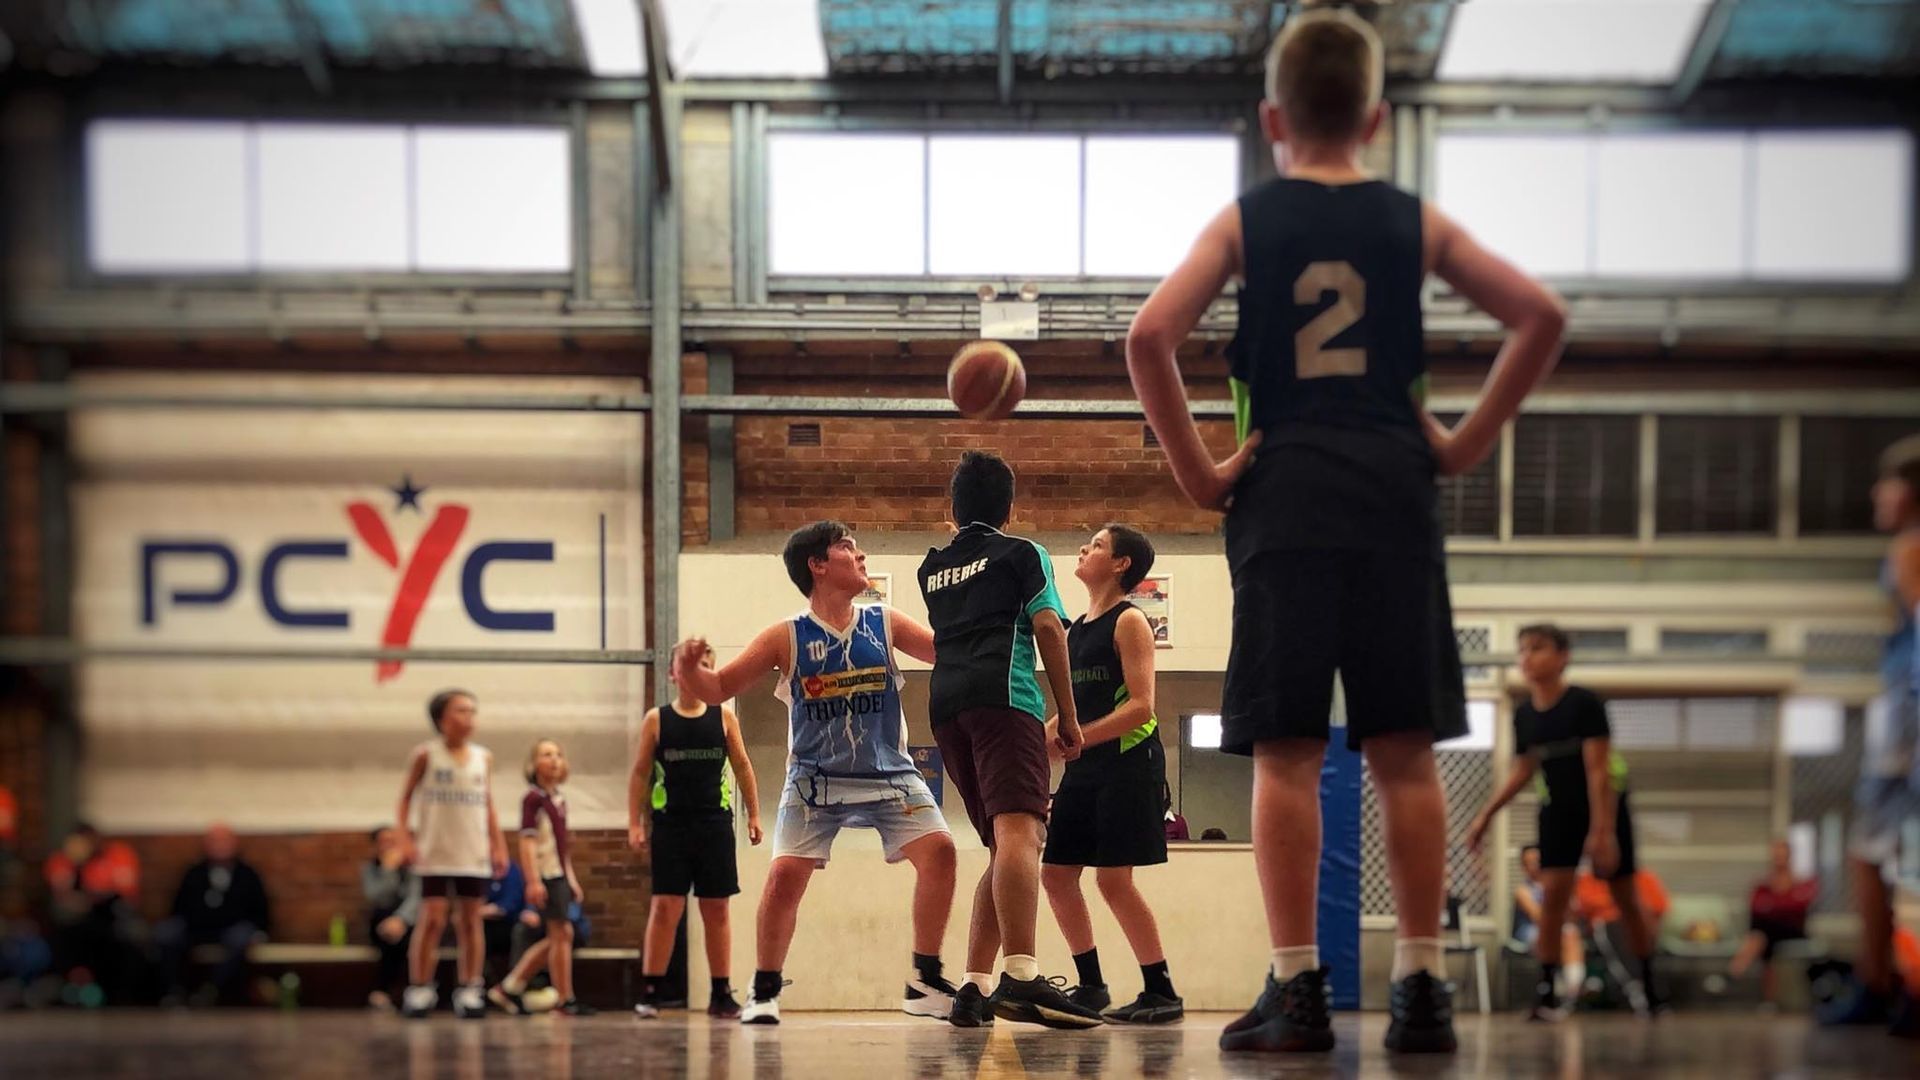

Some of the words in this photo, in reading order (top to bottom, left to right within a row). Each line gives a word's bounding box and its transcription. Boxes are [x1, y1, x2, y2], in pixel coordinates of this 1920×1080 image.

[1293, 260, 1367, 379] 2
[139, 501, 555, 684] PCYC
[926, 557, 989, 594] REFEREE
[806, 640, 827, 662] 10
